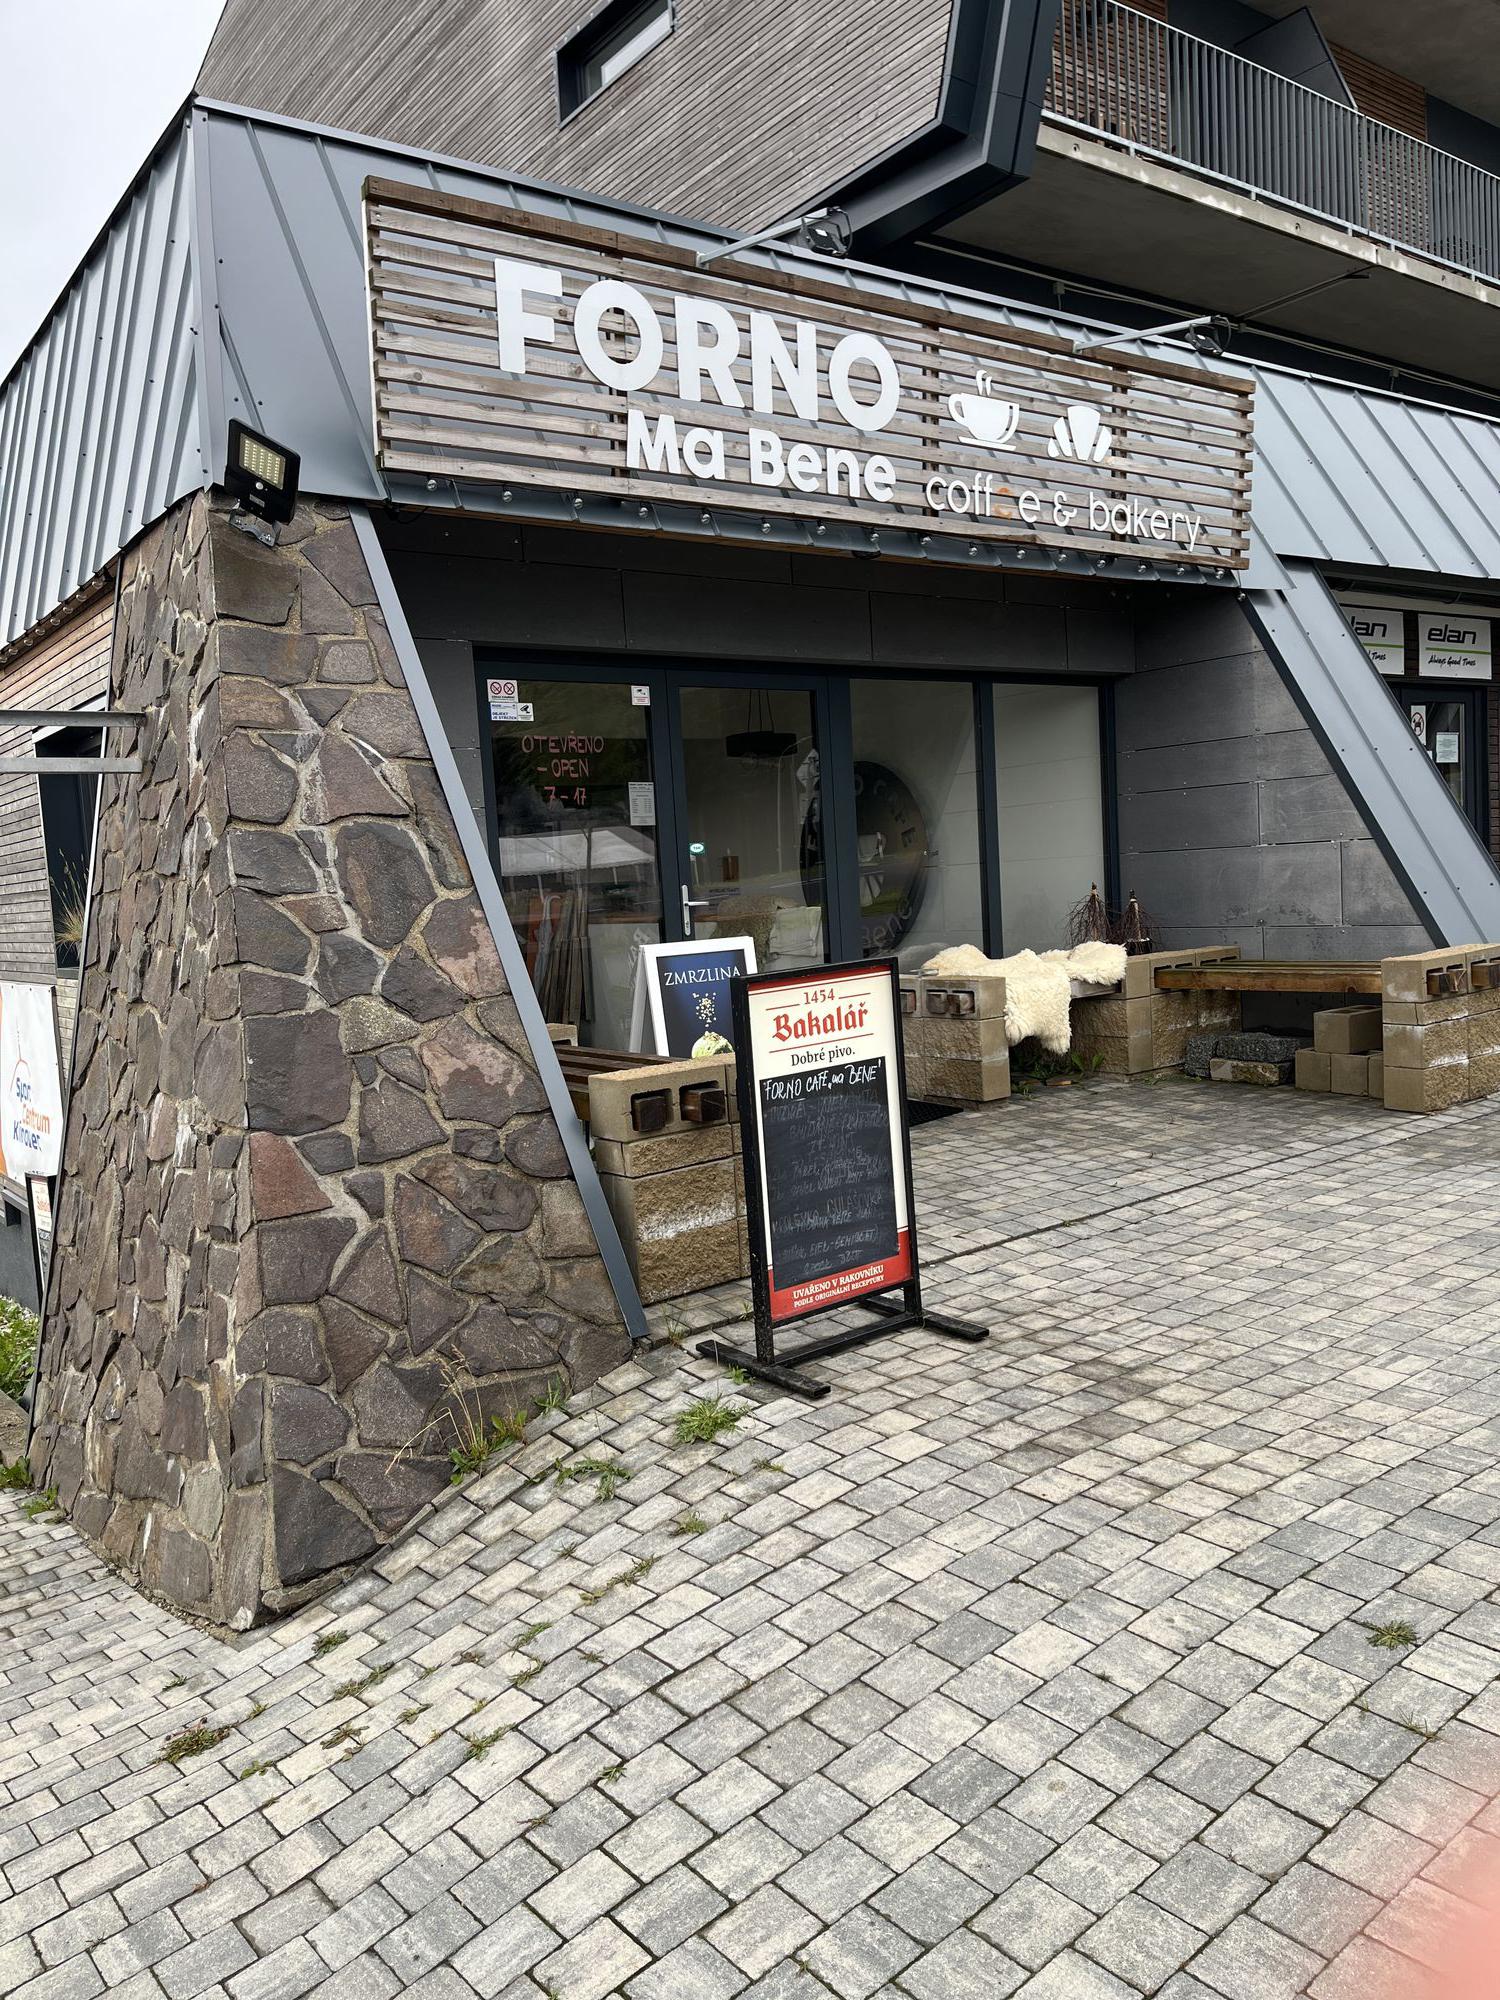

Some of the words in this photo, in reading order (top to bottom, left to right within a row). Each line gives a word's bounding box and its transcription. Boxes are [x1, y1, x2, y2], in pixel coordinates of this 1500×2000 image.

[494, 258, 901, 431] FORNO
[627, 409, 725, 480] Ma
[749, 427, 897, 503] Bene
[926, 472, 1041, 523] coffe
[1053, 491, 1077, 527] &
[1089, 491, 1201, 552] bakery
[1350, 616, 1387, 637] lan
[1427, 624, 1477, 645] elan
[1428, 654, 1446, 668] Always
[1447, 656, 1462, 667] Good
[1462, 657, 1477, 667] Times
[521, 731, 605, 753] OTEVŘENO
[551, 759, 589, 778] OPEN
[664, 966, 741, 986] ZMRZLINA
[803, 988, 835, 1005] 1454
[772, 1001, 869, 1042] Bakalář
[791, 1048, 826, 1067] Dobré
[828, 1045, 856, 1063] pivo.
[764, 1078, 802, 1101] FORNO
[805, 1070, 829, 1092] CAFE
[792, 1281, 831, 1299] UVAŘENO
[832, 1278, 838, 1287] V
[839, 1264, 884, 1285] RAKOVNÍKU
[793, 1296, 814, 1308] PODLE
[814, 1284, 850, 1302] ORIGINÁLNÍ
[851, 1275, 885, 1290] RECEPTURY
